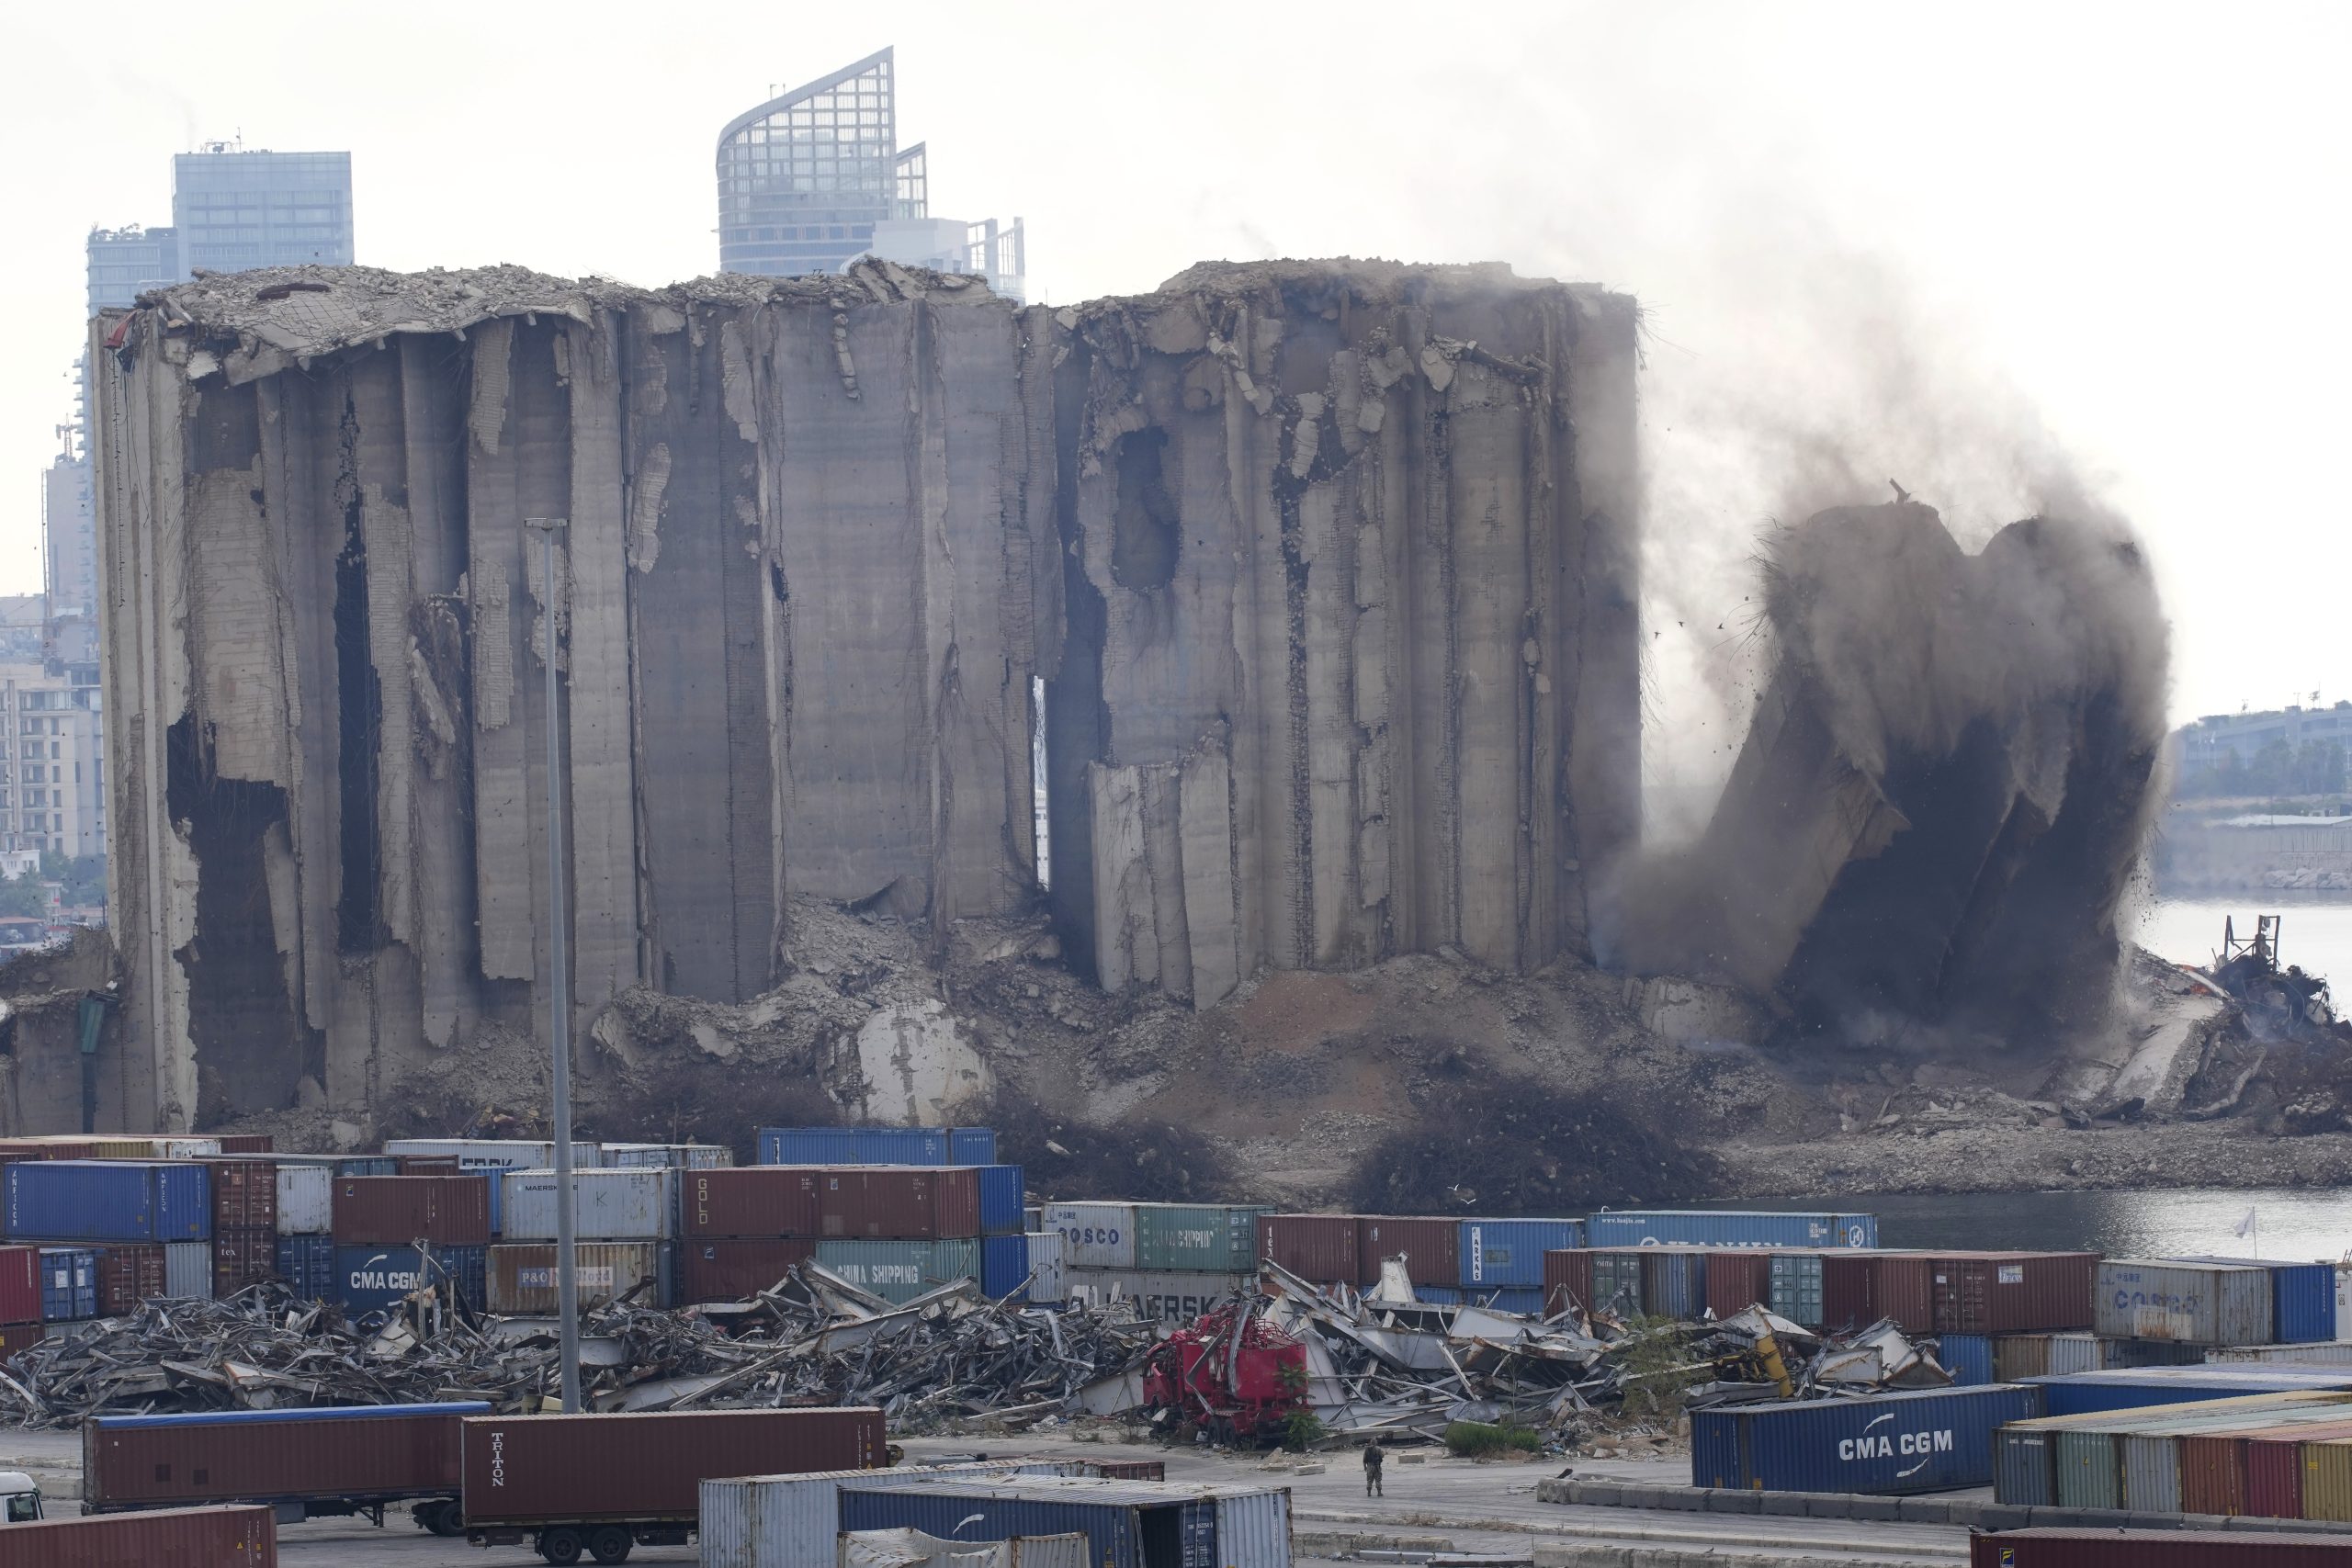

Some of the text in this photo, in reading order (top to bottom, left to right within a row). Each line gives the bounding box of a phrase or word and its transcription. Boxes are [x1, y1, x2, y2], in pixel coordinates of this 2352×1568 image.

[698, 1178, 707, 1224] GOLD
[221, 1247, 236, 1256] tex
[350, 1271, 421, 1290] CMA CGM
[522, 1272, 548, 1283] P&O
[872, 1265, 918, 1284] SHIPPING
[1838, 1429, 1953, 1461] CMA CGM
[492, 1432, 504, 1487] TRITON
